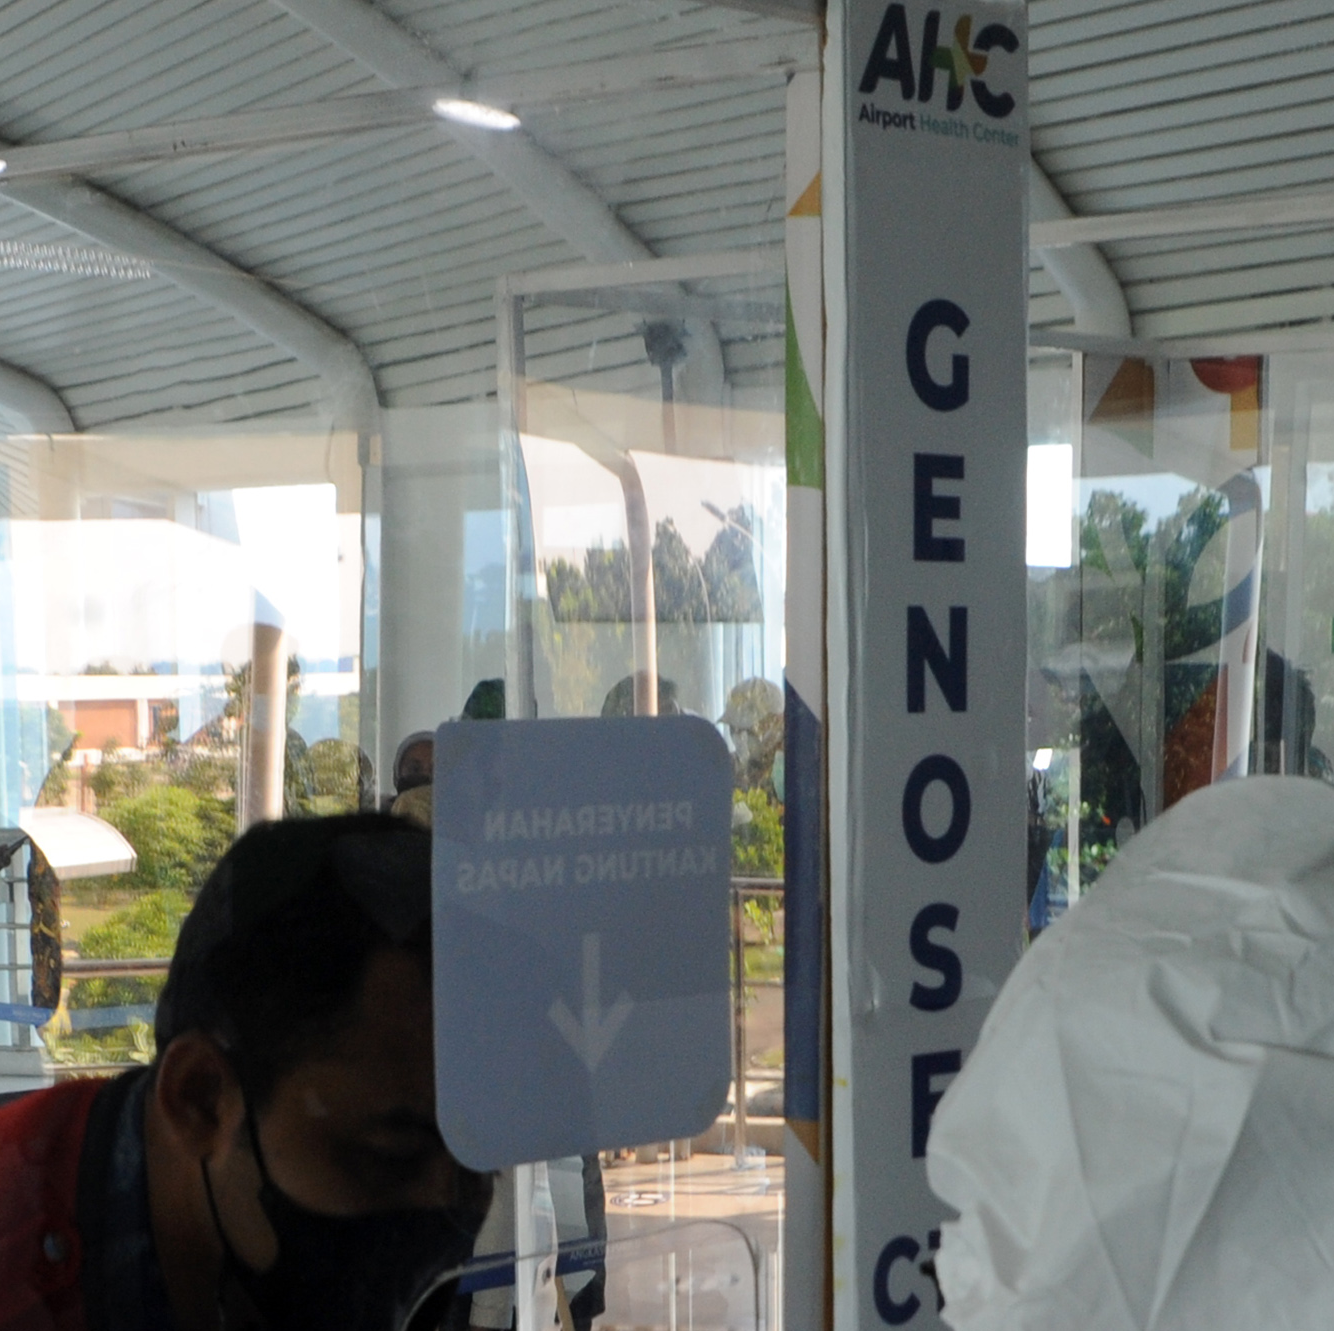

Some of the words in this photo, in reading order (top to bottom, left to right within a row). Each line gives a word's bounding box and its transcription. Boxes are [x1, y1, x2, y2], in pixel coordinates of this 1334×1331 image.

[859, 3, 1020, 118] AHC
[859, 102, 916, 131] Airport
[919, 113, 969, 139] Health
[972, 122, 1019, 147] Center
